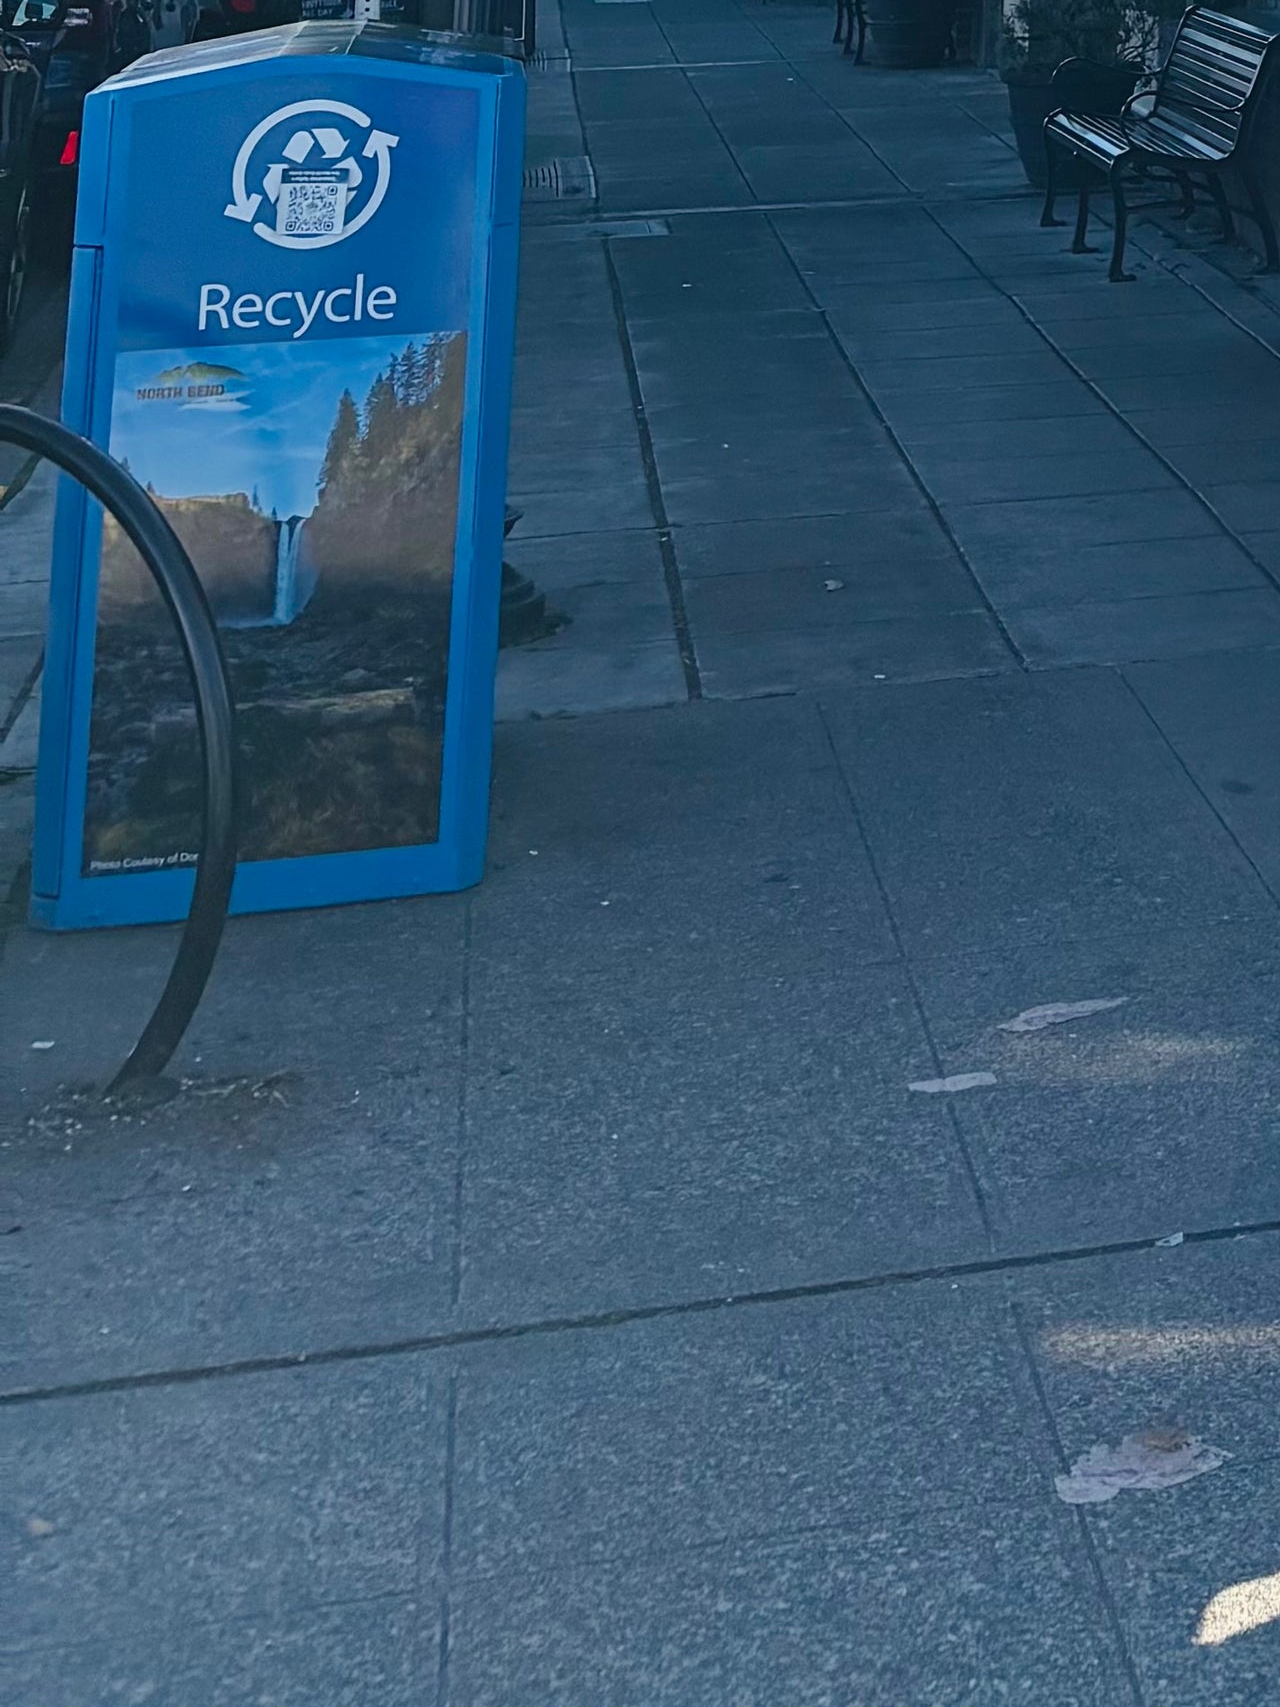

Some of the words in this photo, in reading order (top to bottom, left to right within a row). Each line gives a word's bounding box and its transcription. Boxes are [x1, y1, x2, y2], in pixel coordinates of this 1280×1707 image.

[198, 280, 398, 339] Recycle
[136, 386, 183, 401] NORTH
[187, 383, 225, 398] BEND
